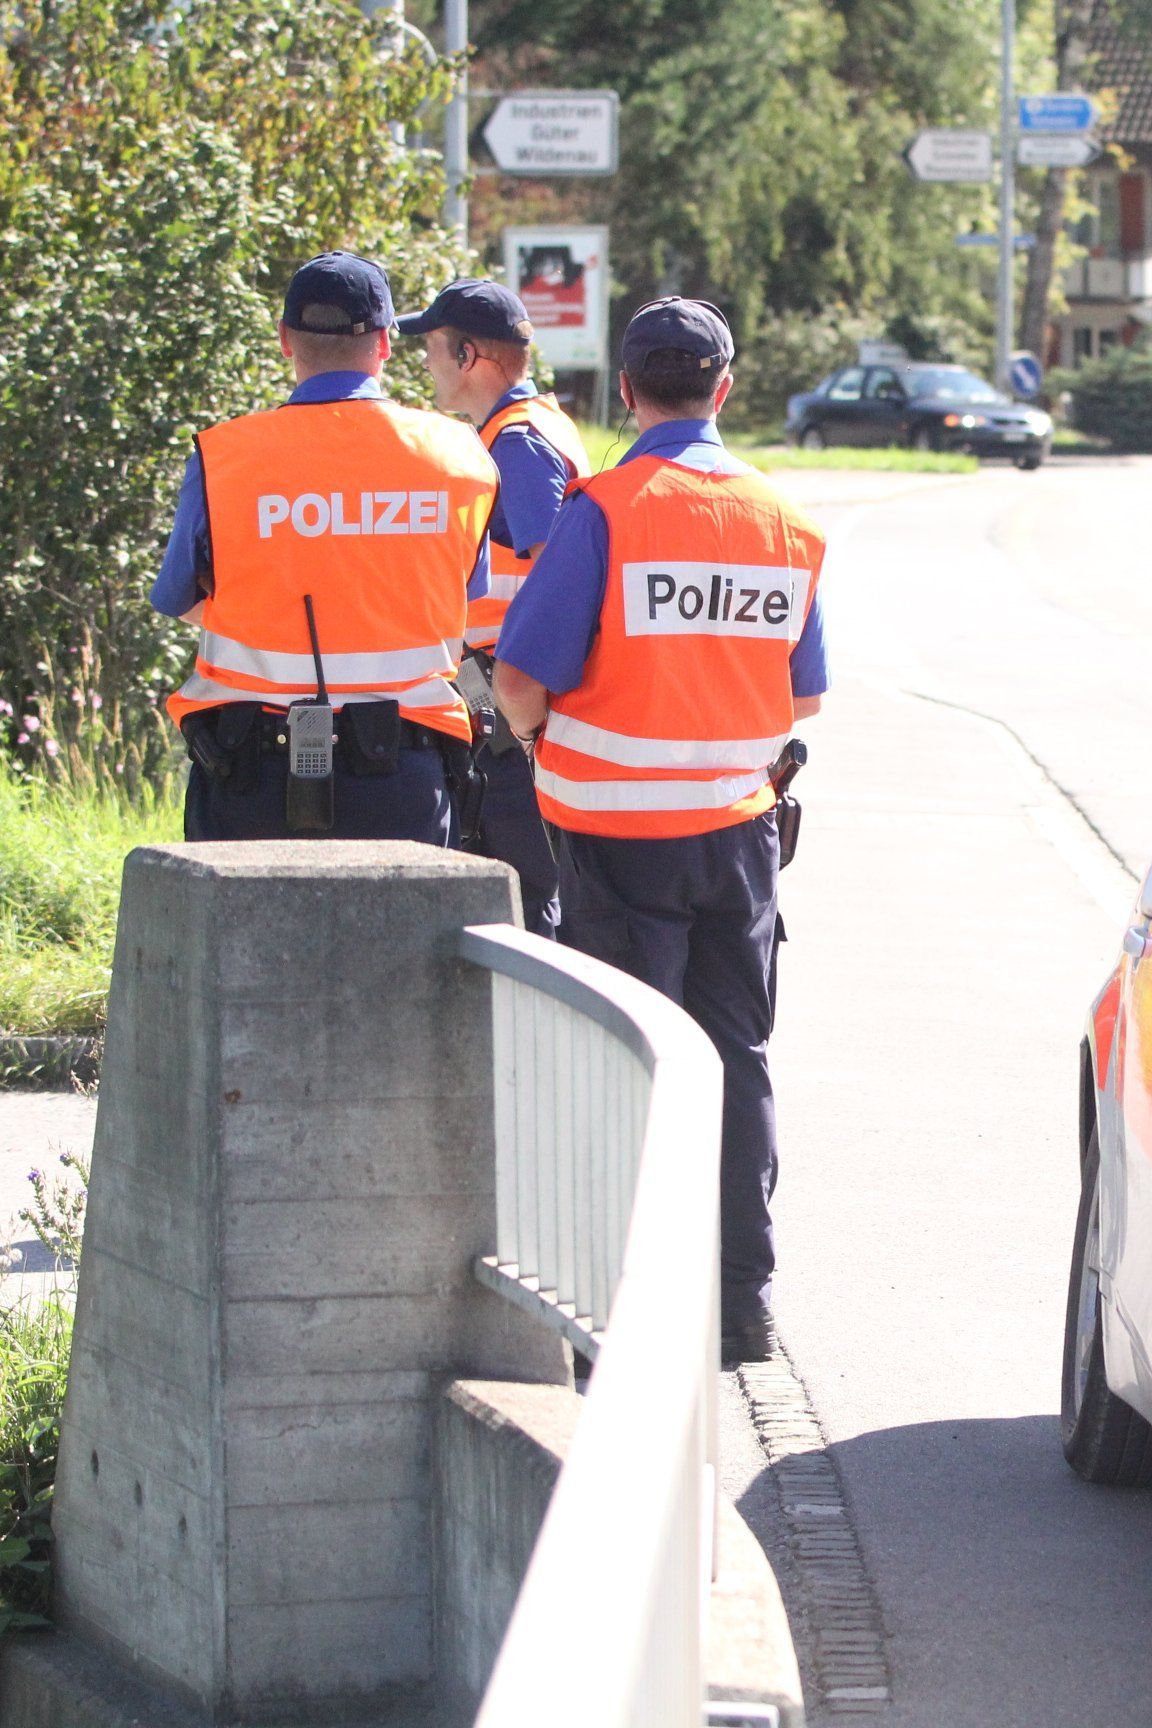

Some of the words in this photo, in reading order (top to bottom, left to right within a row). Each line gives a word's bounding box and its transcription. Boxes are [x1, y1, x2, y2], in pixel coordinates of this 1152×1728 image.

[511, 103, 603, 119] Industrien
[516, 146, 599, 162] Wildenau
[257, 490, 449, 539] POLIZEI
